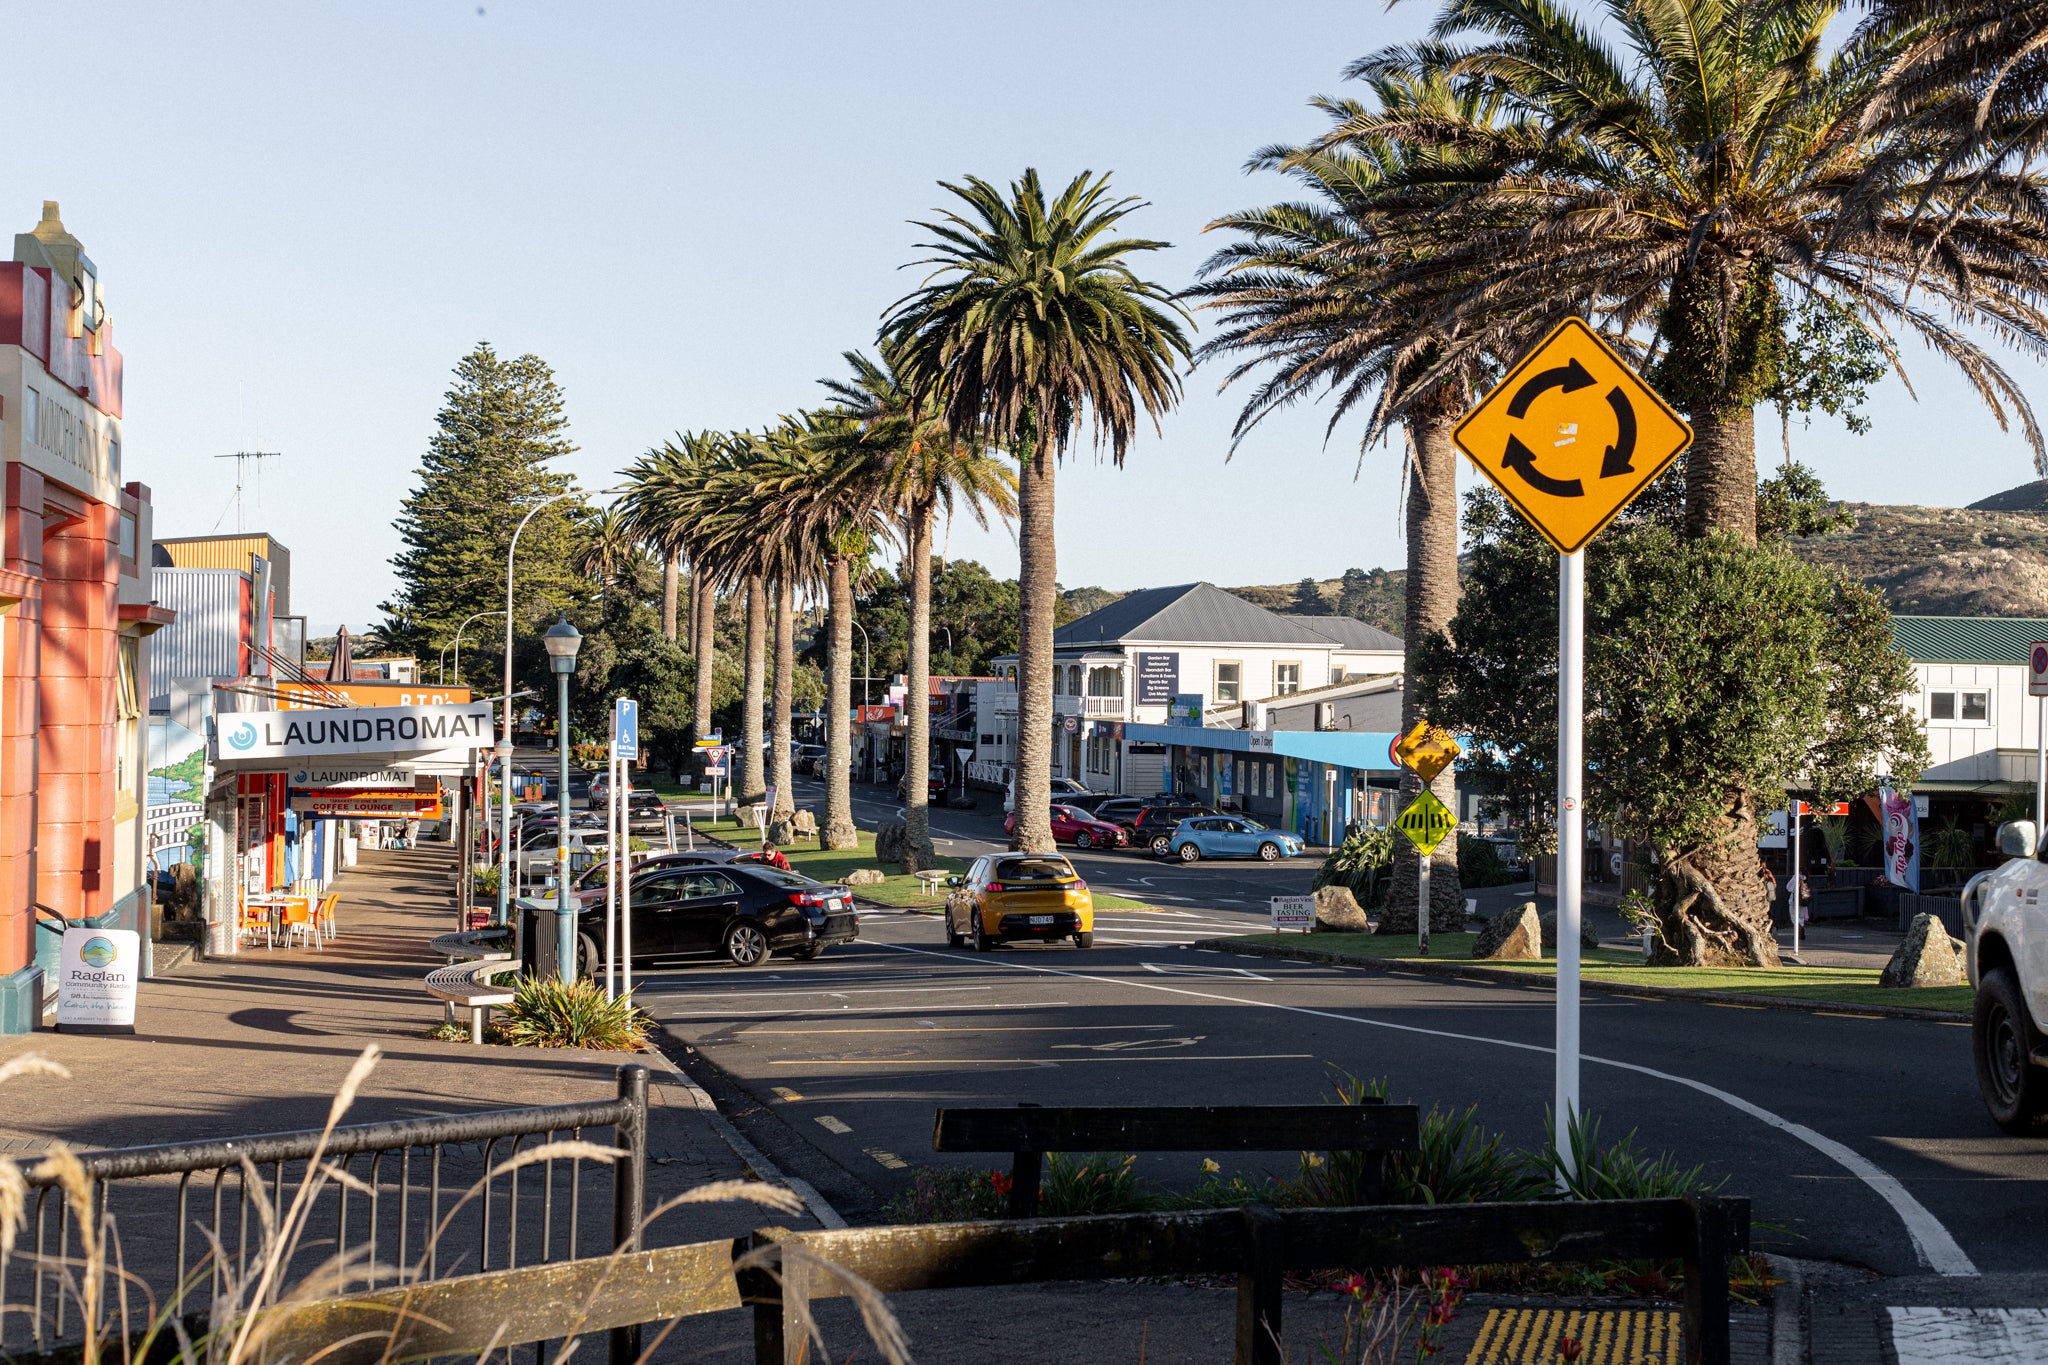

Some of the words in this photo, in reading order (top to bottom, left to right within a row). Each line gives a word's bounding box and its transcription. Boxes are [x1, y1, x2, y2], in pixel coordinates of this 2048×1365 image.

[623, 702, 630, 716] P
[265, 713, 487, 746] LAUNDROMAT
[1250, 735, 1260, 748] Open
[312, 771, 409, 782] LAUNDROMAT
[1894, 832, 1906, 855] Top
[1896, 855, 1907, 874] Tip
[71, 971, 125, 982] Raglan
[65, 981, 108, 989] Community
